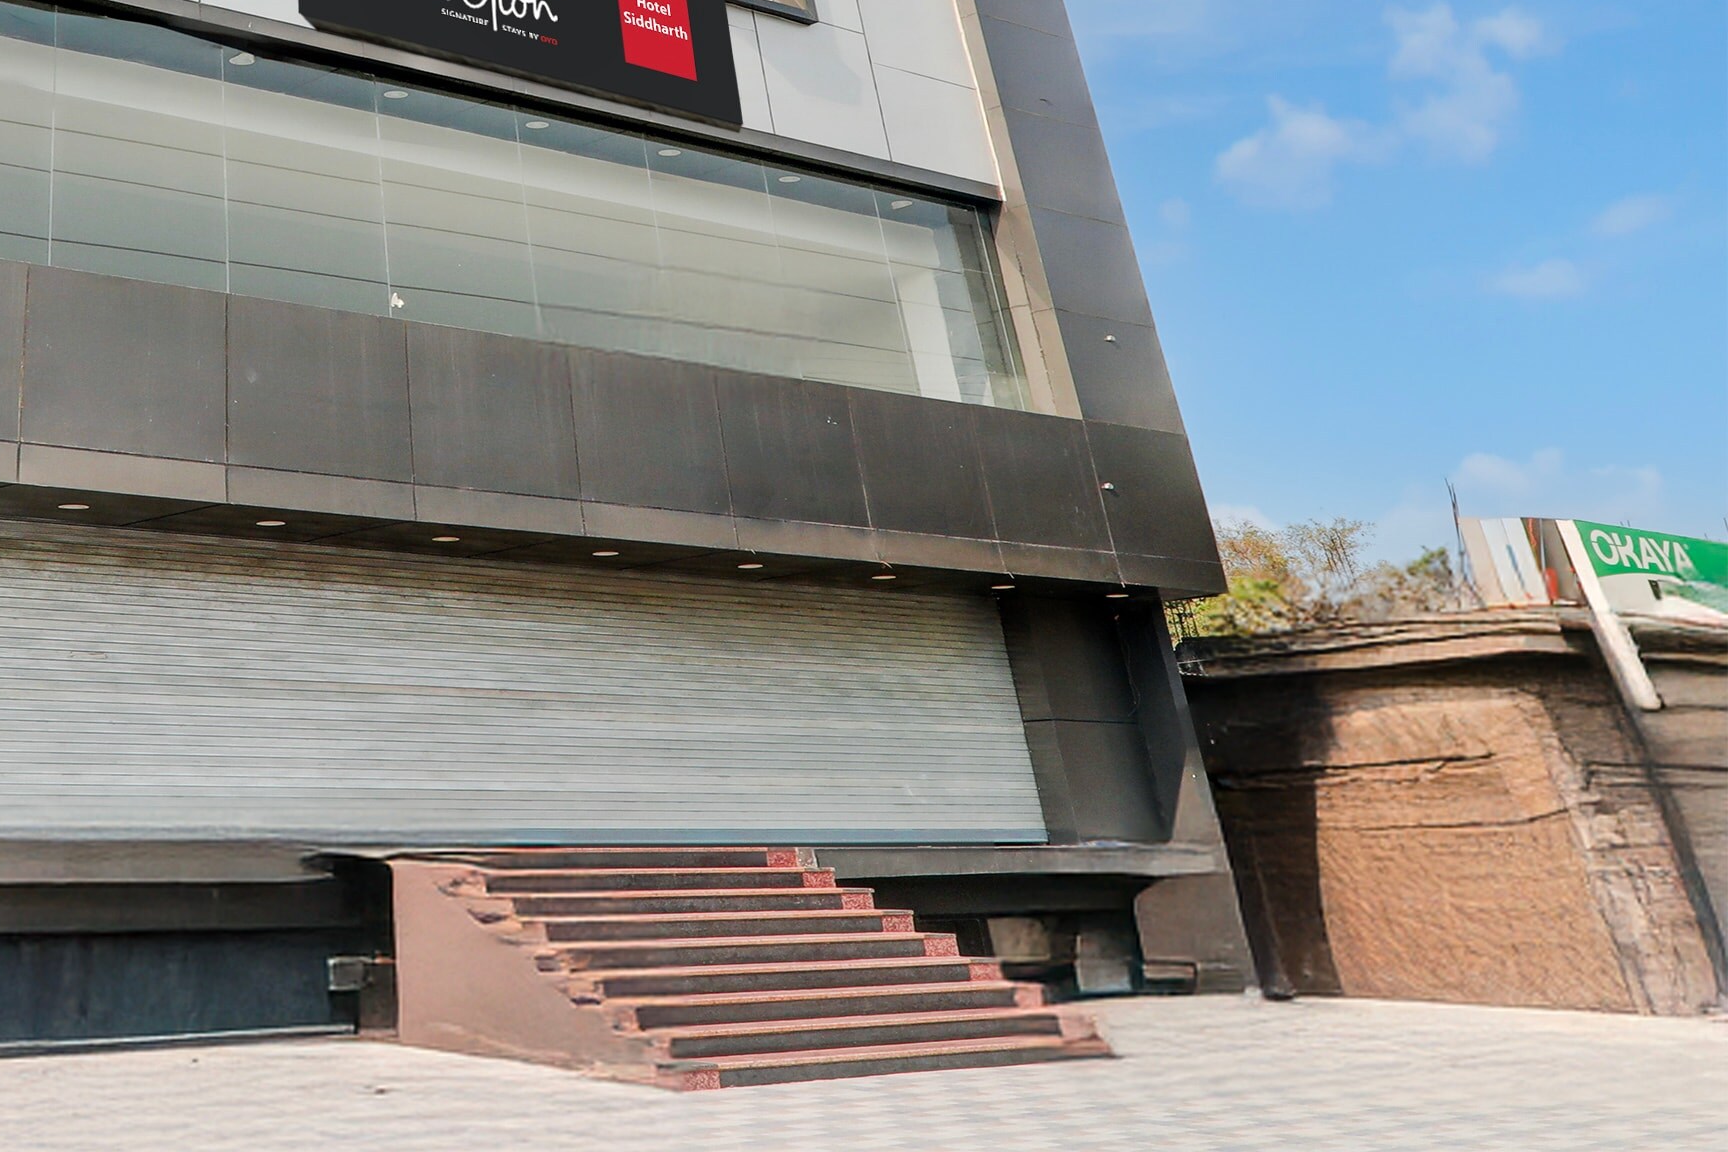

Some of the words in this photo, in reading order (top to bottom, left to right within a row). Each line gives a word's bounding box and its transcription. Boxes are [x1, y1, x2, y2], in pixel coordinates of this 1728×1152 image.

[440, 8, 489, 26] SIGNATURE
[502, 24, 526, 37] STAYS
[623, 11, 688, 40] Siddharth
[1590, 529, 1699, 579] OKAYA
